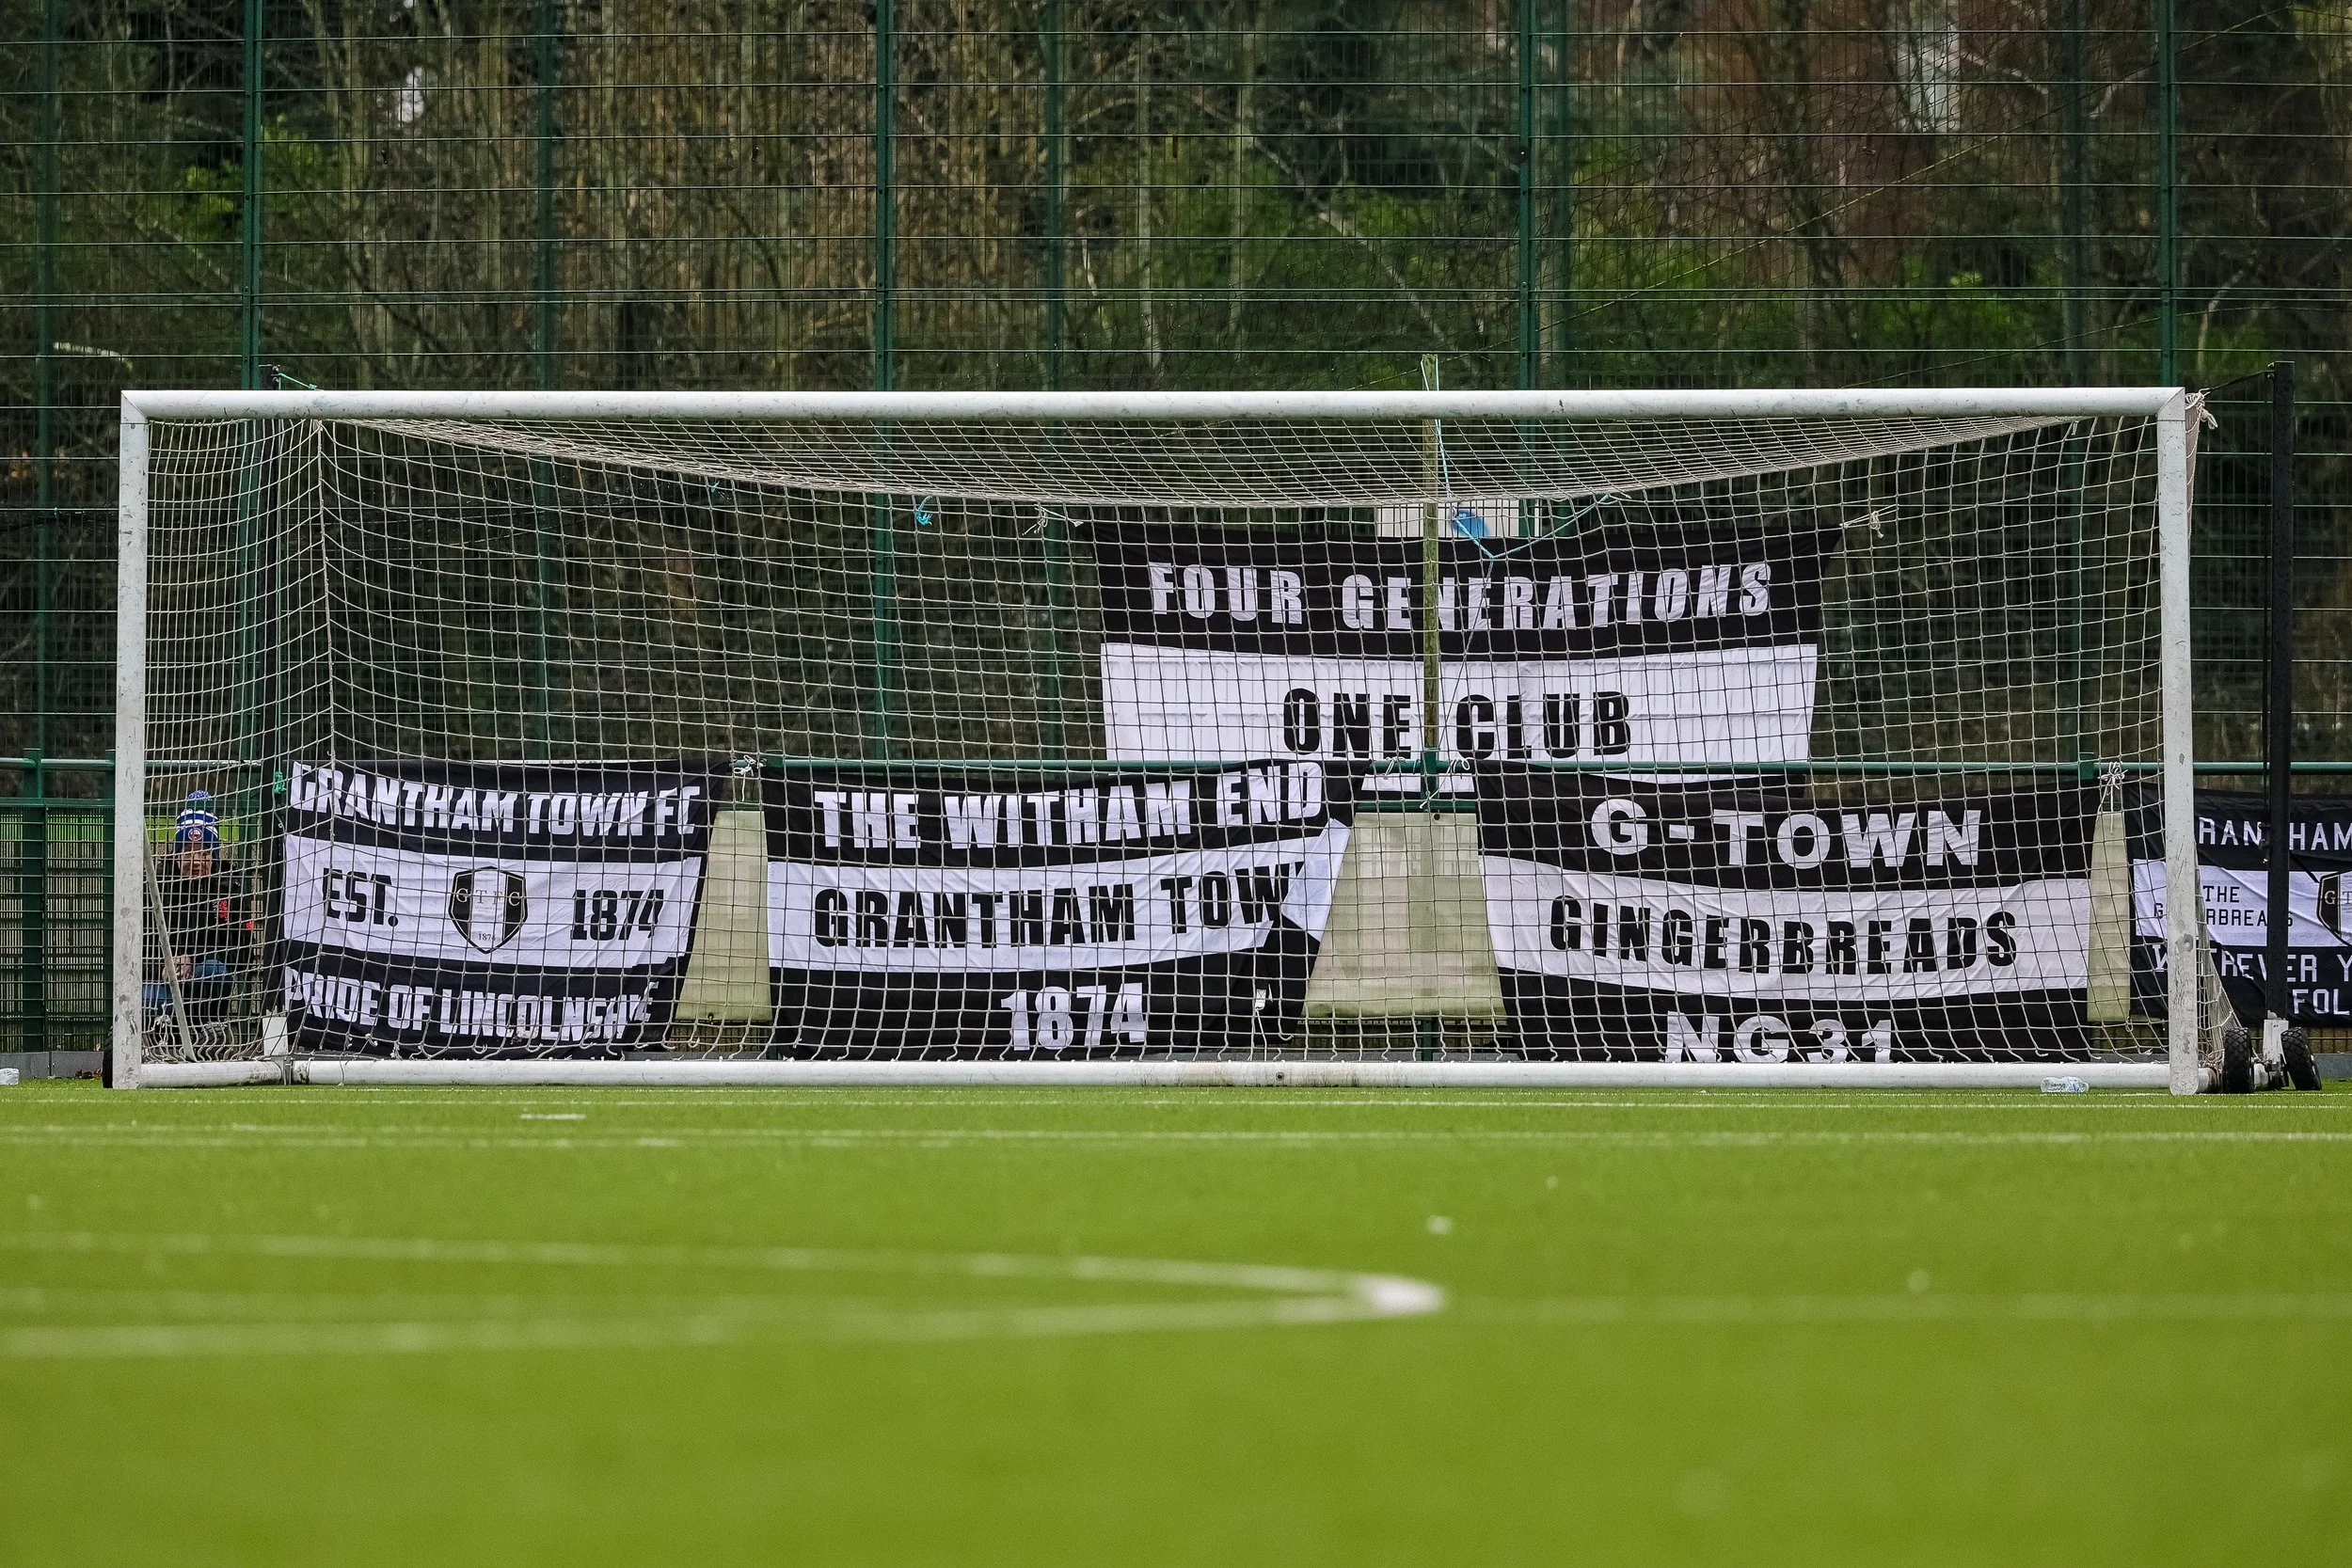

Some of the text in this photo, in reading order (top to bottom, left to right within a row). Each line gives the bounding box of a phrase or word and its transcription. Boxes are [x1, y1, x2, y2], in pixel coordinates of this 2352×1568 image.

[1150, 561, 1772, 630] FOUR GENERATIONS
[1282, 688, 1631, 760] ONE CLUB
[290, 761, 700, 836] GRANTHAM TOWN FC
[814, 762, 1324, 849] THE WITHAM END
[1590, 799, 1981, 870] G-TOWN
[2200, 816, 2352, 851] RANHAM
[323, 867, 399, 927] EST.
[570, 888, 664, 942] 1874
[814, 860, 1305, 949] GRANTHAM TOW
[2203, 885, 2240, 904] THE
[1549, 895, 2018, 974] GINGERBREADS
[284, 966, 381, 1026] PRIDE
[388, 985, 433, 1031] OF
[1001, 983, 1148, 1052] 1874
[2293, 989, 2350, 1016] FOL
[1665, 1010, 1892, 1064] NG31
